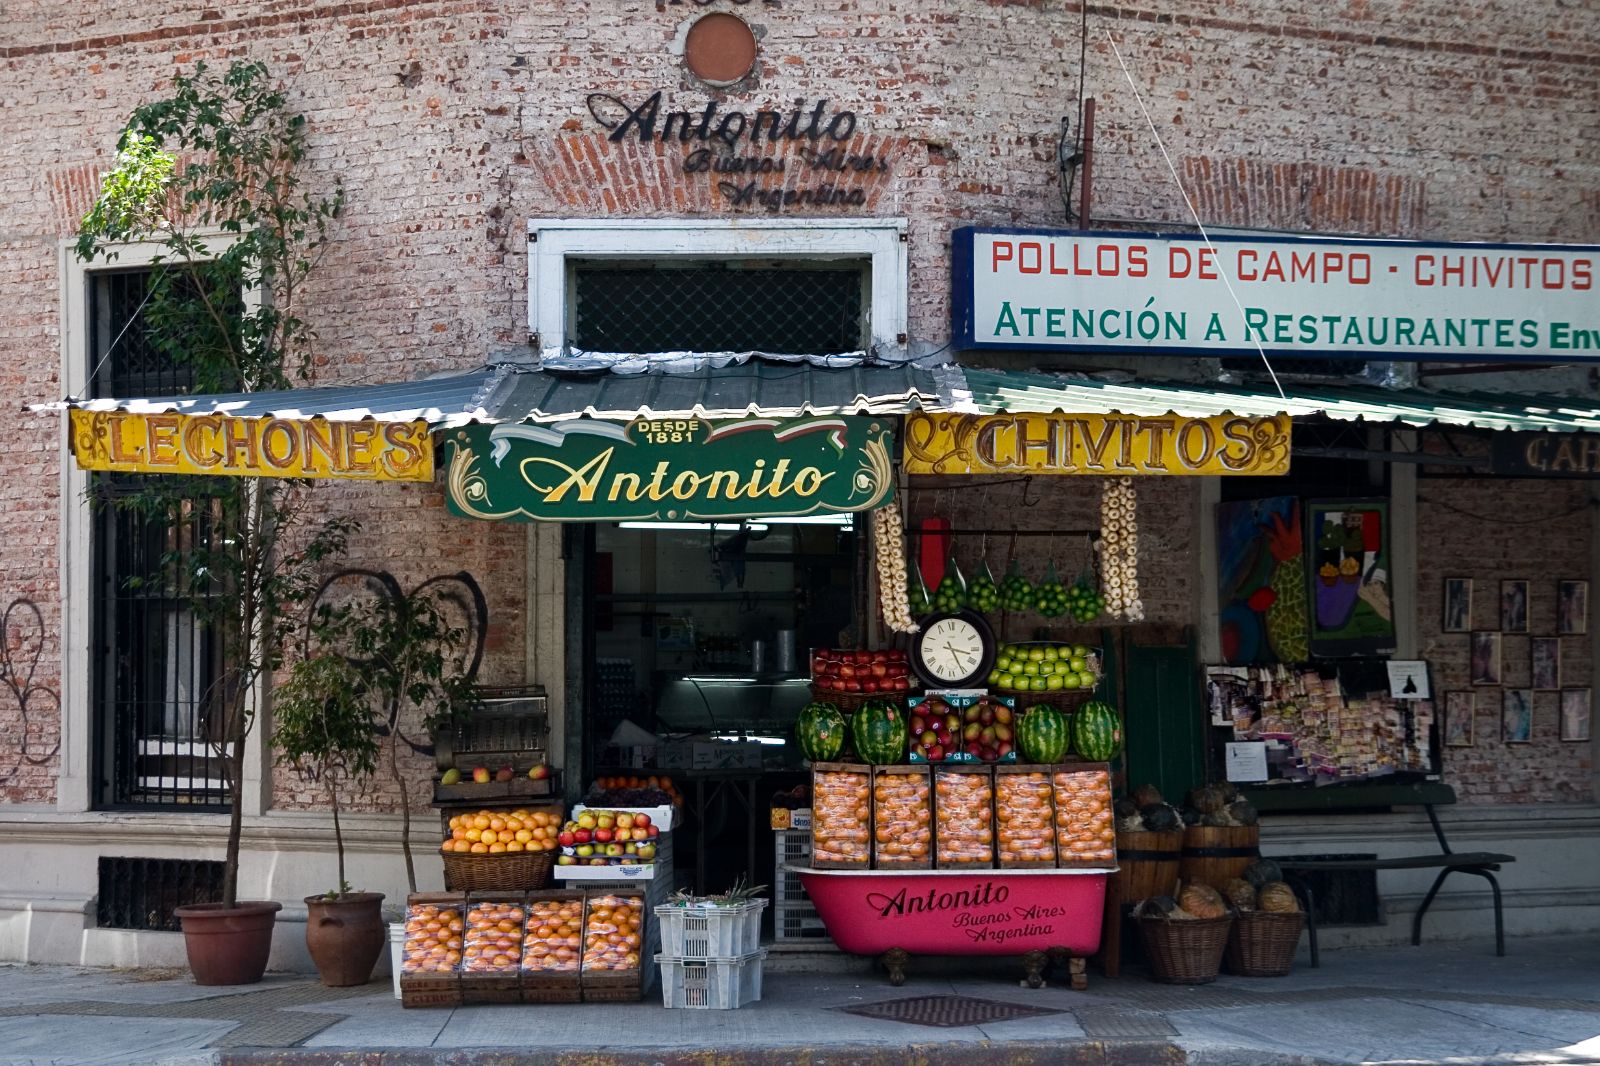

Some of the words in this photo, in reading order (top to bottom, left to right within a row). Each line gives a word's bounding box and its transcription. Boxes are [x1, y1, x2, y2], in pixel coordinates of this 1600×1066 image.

[586, 91, 857, 147] Antonito
[682, 149, 785, 172] Buenos
[800, 147, 888, 171] Aires
[718, 181, 866, 211] Argentina
[992, 241, 1148, 278] POLLOS
[1168, 247, 1217, 280] DE
[1237, 249, 1371, 285] CAMPO
[1415, 255, 1593, 290] CHIVITOS
[993, 296, 1187, 342] ATENCIÓN
[1203, 312, 1227, 342] A
[1244, 307, 1540, 349] RESTAURANTES
[106, 414, 423, 472] LECHONES
[638, 421, 698, 432] DESDE
[647, 432, 692, 443] 1881
[975, 416, 1257, 472] CHIVITOS
[519, 446, 837, 503] Antonito
[866, 882, 1009, 917] Antonito
[951, 910, 1013, 928] Buenos
[1013, 903, 1067, 921] Aires
[964, 923, 1055, 944] Argentina
